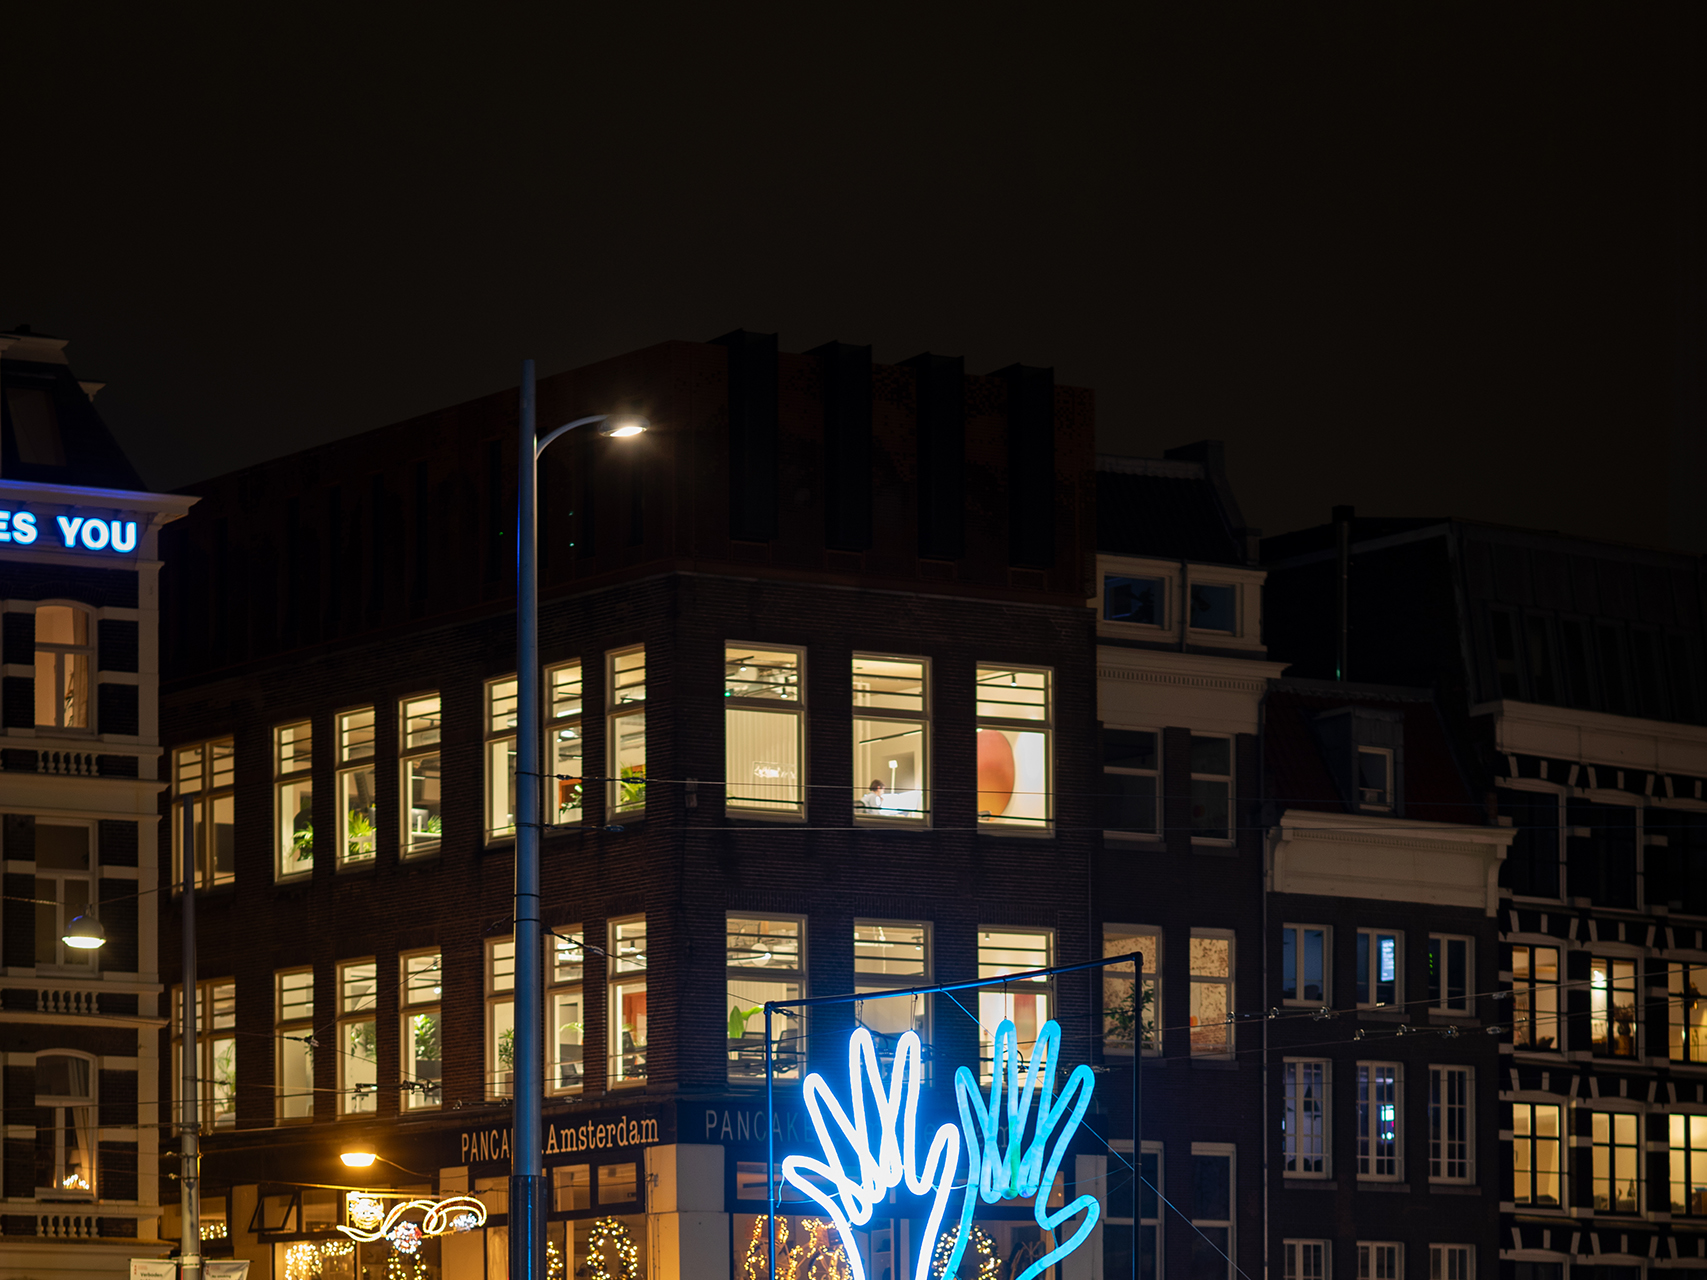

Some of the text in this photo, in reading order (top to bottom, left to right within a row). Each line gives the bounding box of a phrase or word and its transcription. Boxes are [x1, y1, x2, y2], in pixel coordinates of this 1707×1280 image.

[56, 515, 137, 553] YOU
[461, 1115, 659, 1163] PANCA Amsterdam
[705, 1109, 815, 1142] PANCAKE
